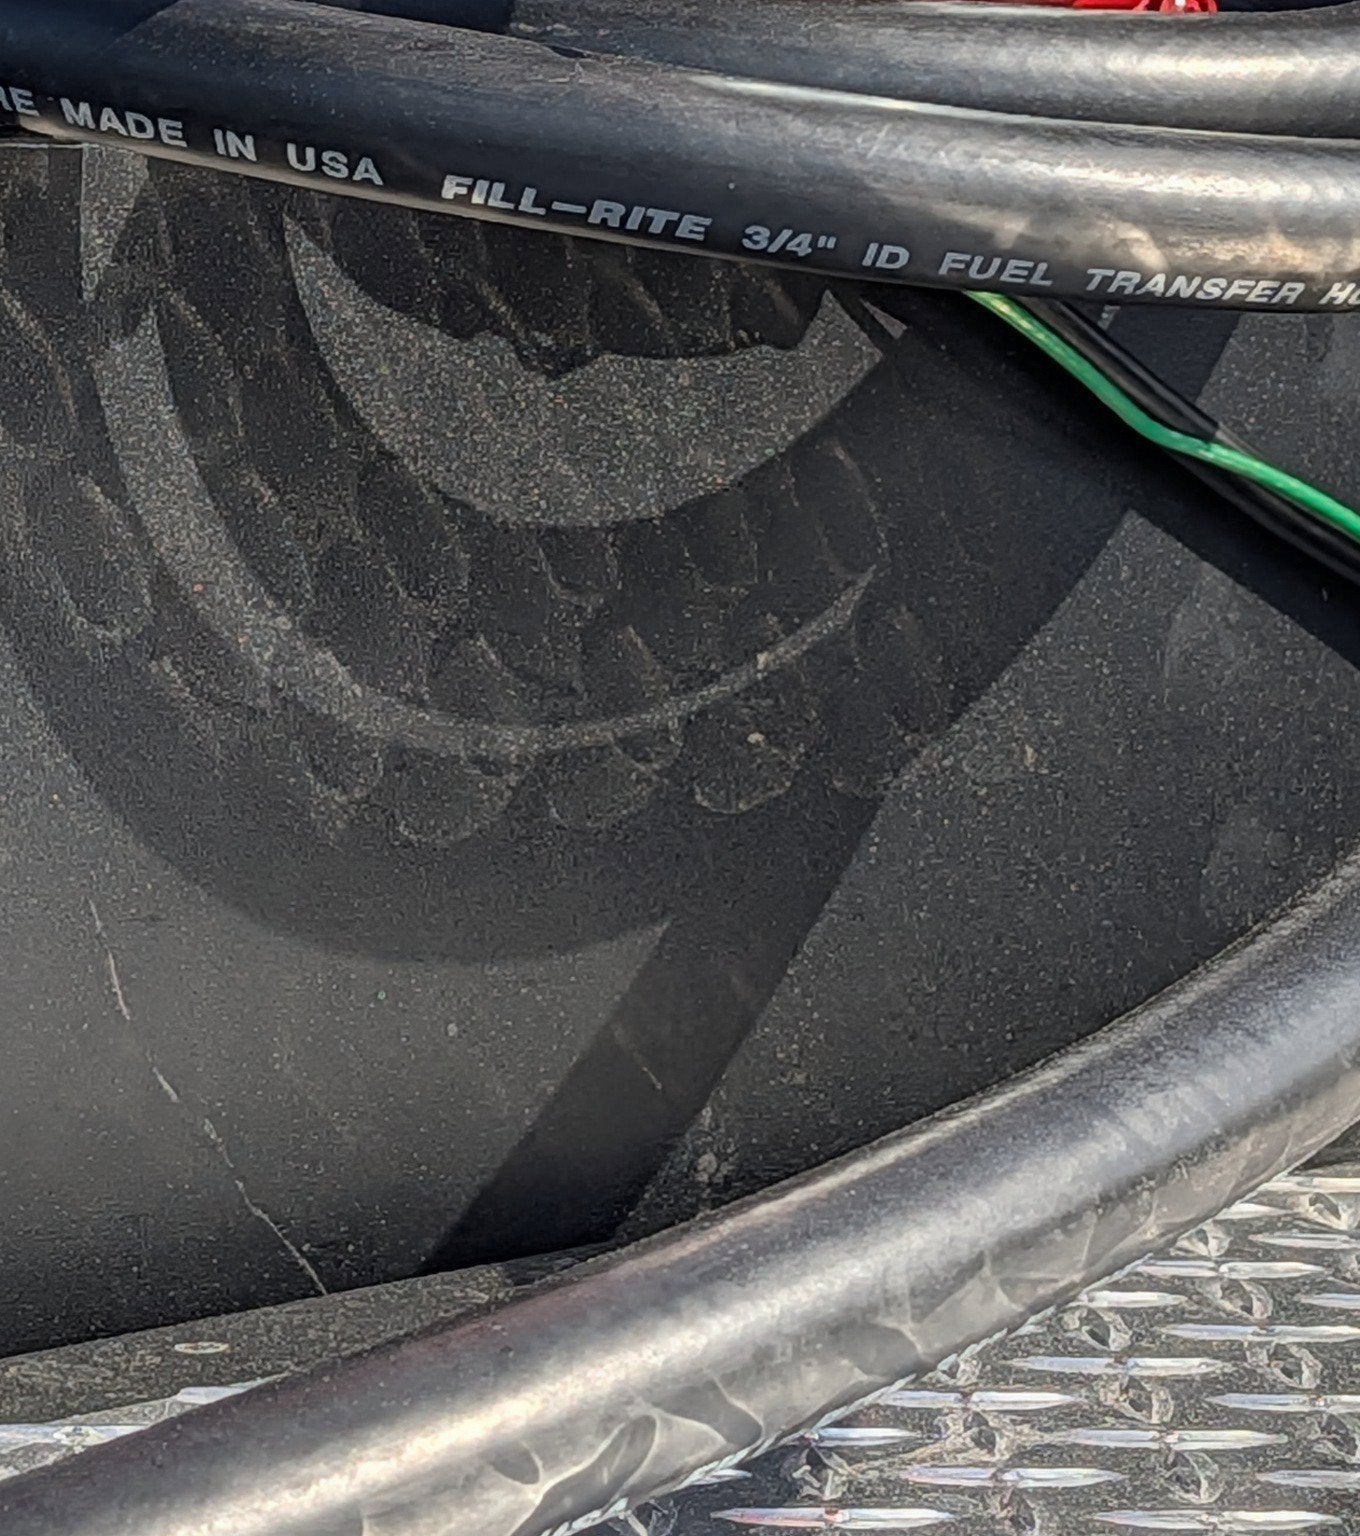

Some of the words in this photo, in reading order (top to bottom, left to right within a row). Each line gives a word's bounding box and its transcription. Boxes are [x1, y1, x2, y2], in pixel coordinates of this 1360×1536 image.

[60, 97, 189, 148] MADE
[213, 128, 258, 162] IN
[286, 142, 385, 186] USA
[440, 174, 713, 242] FILL-RITE
[740, 224, 838, 258] 3/4"
[860, 241, 911, 271] ID
[937, 250, 1055, 287] FUEL
[1086, 267, 1307, 306] TRANSFER
